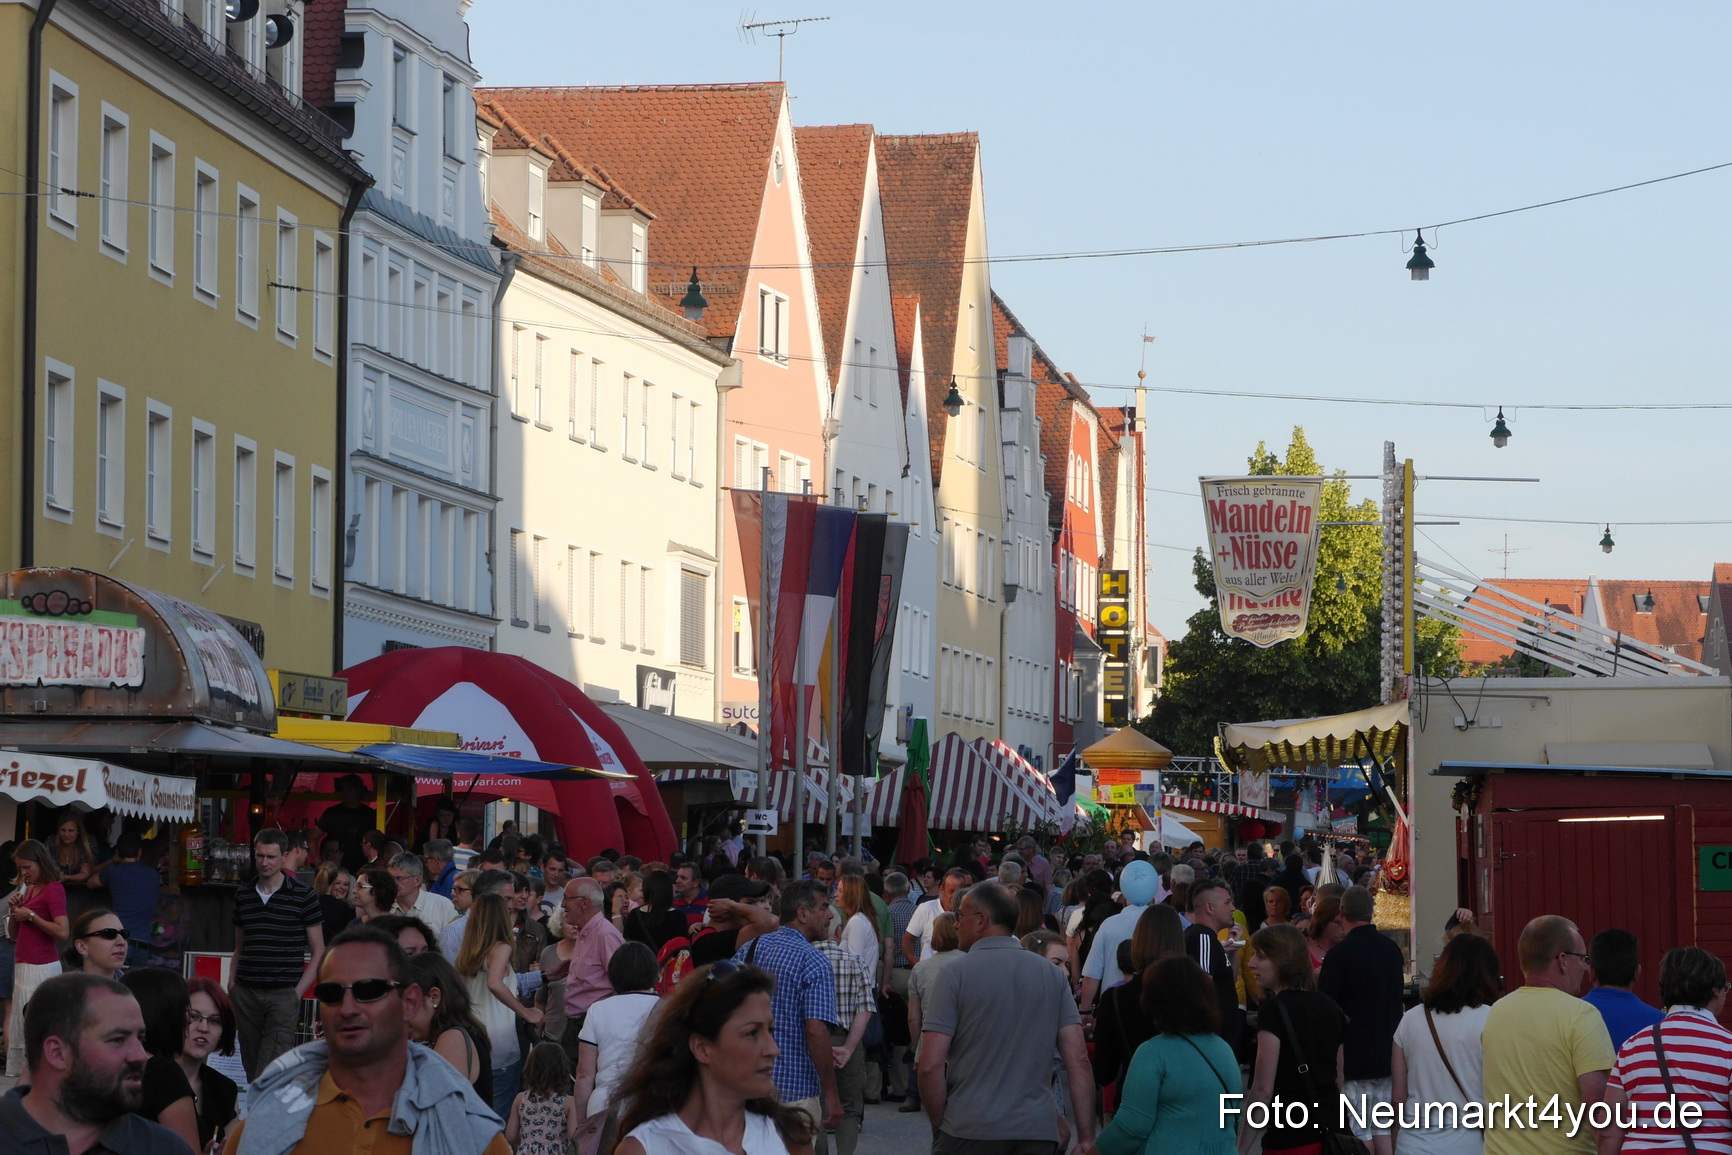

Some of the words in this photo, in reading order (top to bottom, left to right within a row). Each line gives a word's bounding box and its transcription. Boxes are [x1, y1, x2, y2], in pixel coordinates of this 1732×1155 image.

[1216, 485, 1250, 498] Frisch
[1253, 485, 1306, 499] gebrannte
[1208, 499, 1312, 534] Mandeln
[1225, 576, 1242, 585] aus
[1245, 573, 1267, 586] aller
[1270, 572, 1298, 585] Welt!
[1100, 573, 1128, 723] HOTEL
[755, 813, 768, 821] WC
